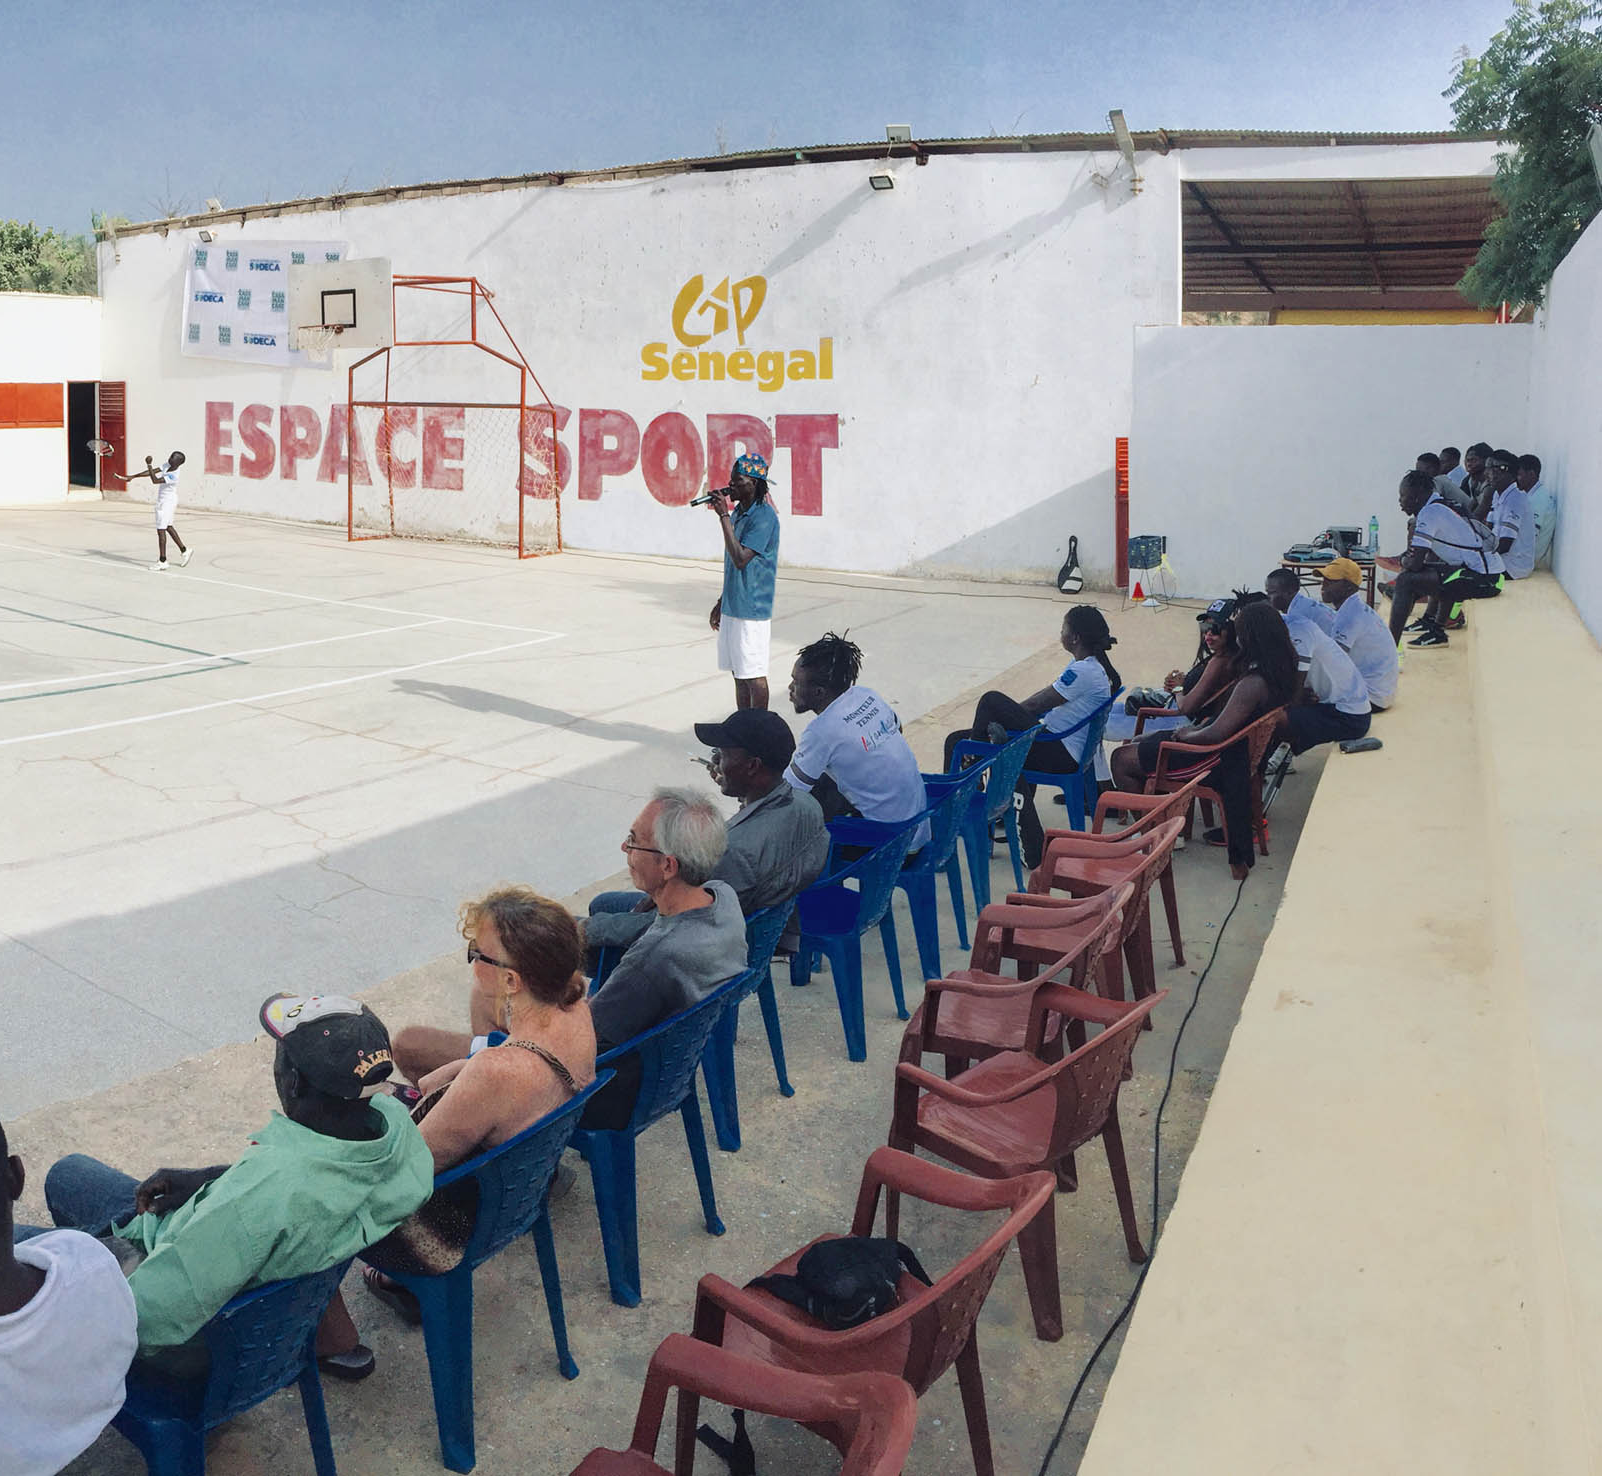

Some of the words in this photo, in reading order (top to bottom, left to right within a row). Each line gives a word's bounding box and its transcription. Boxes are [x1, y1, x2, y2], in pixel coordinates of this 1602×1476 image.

[204, 401, 465, 491] ESPACE
[516, 403, 839, 516] SPORT
[856, 707, 879, 728] TENNIS
[353, 1049, 390, 1078] PALER
